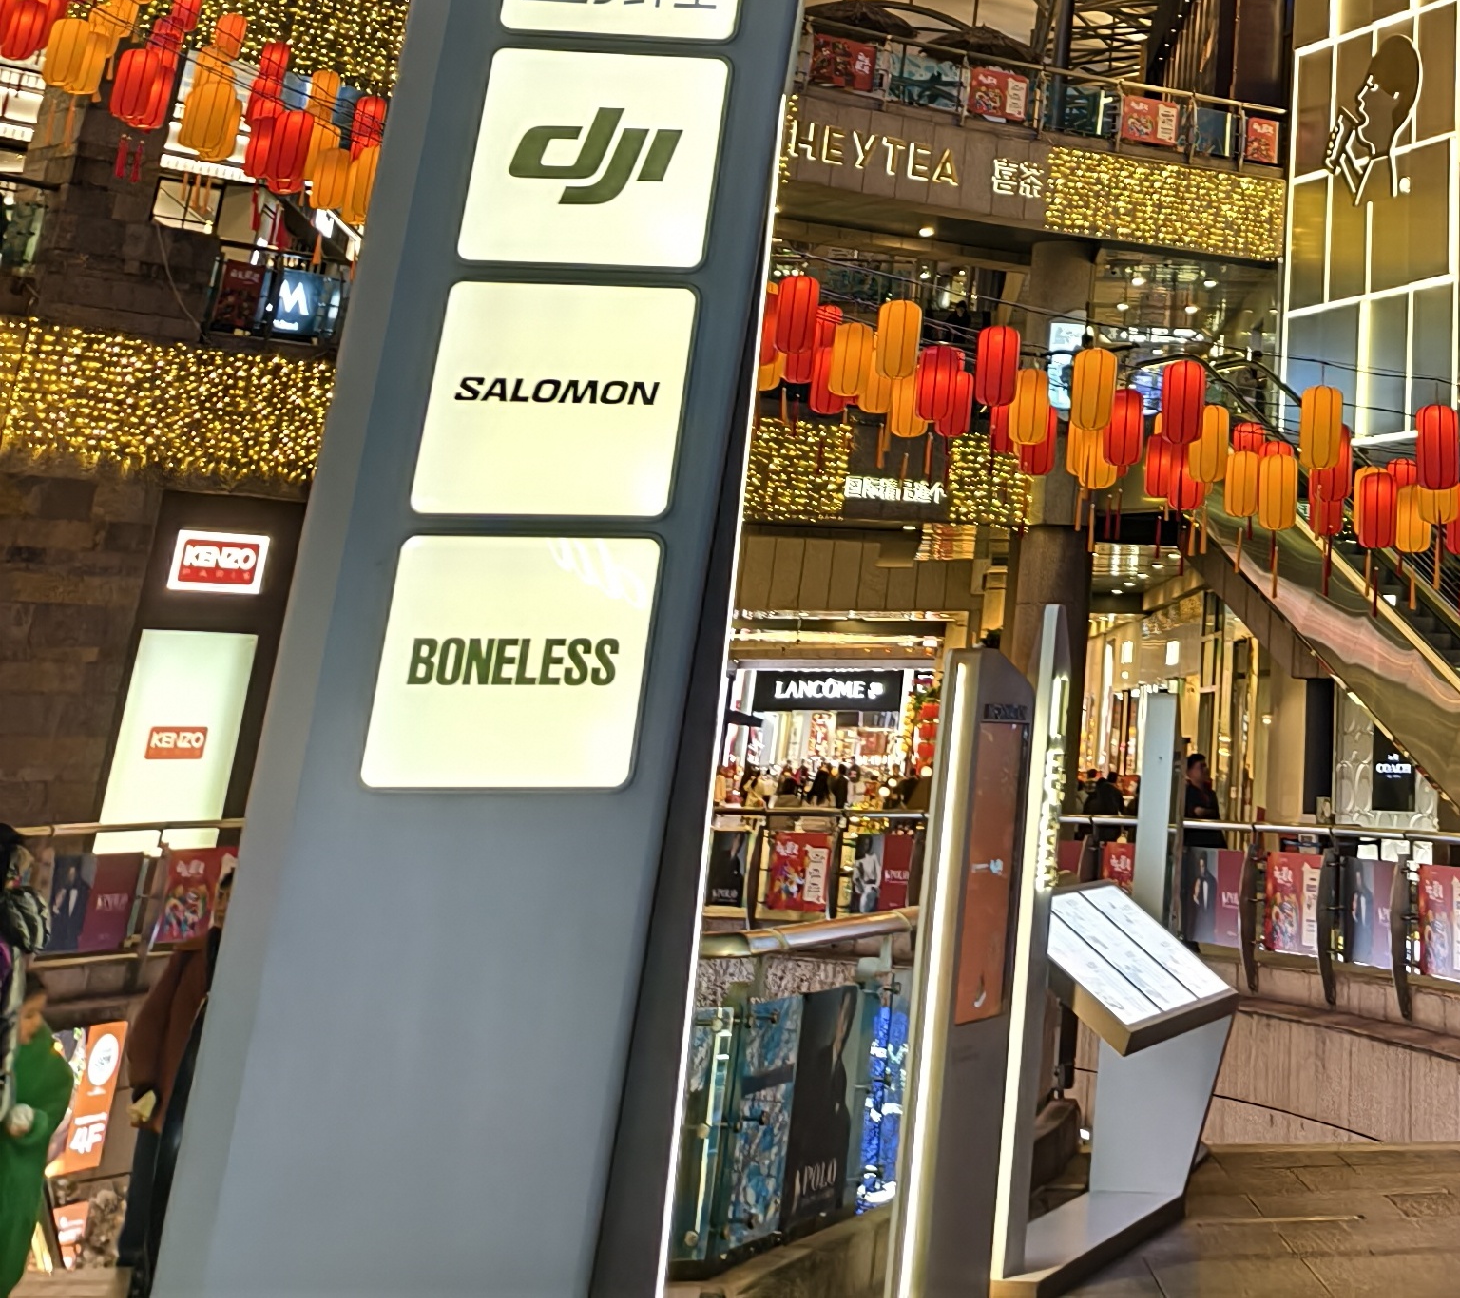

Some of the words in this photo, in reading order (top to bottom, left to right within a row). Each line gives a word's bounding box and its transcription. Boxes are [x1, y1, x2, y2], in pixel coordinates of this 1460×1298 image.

[786, 119, 959, 187] HEYTEA
[453, 376, 661, 407] SALOMON
[182, 544, 257, 571] KENZO
[406, 637, 620, 687] BONELESS
[149, 731, 205, 749] KENZO
[69, 1122, 106, 1154] 4F
